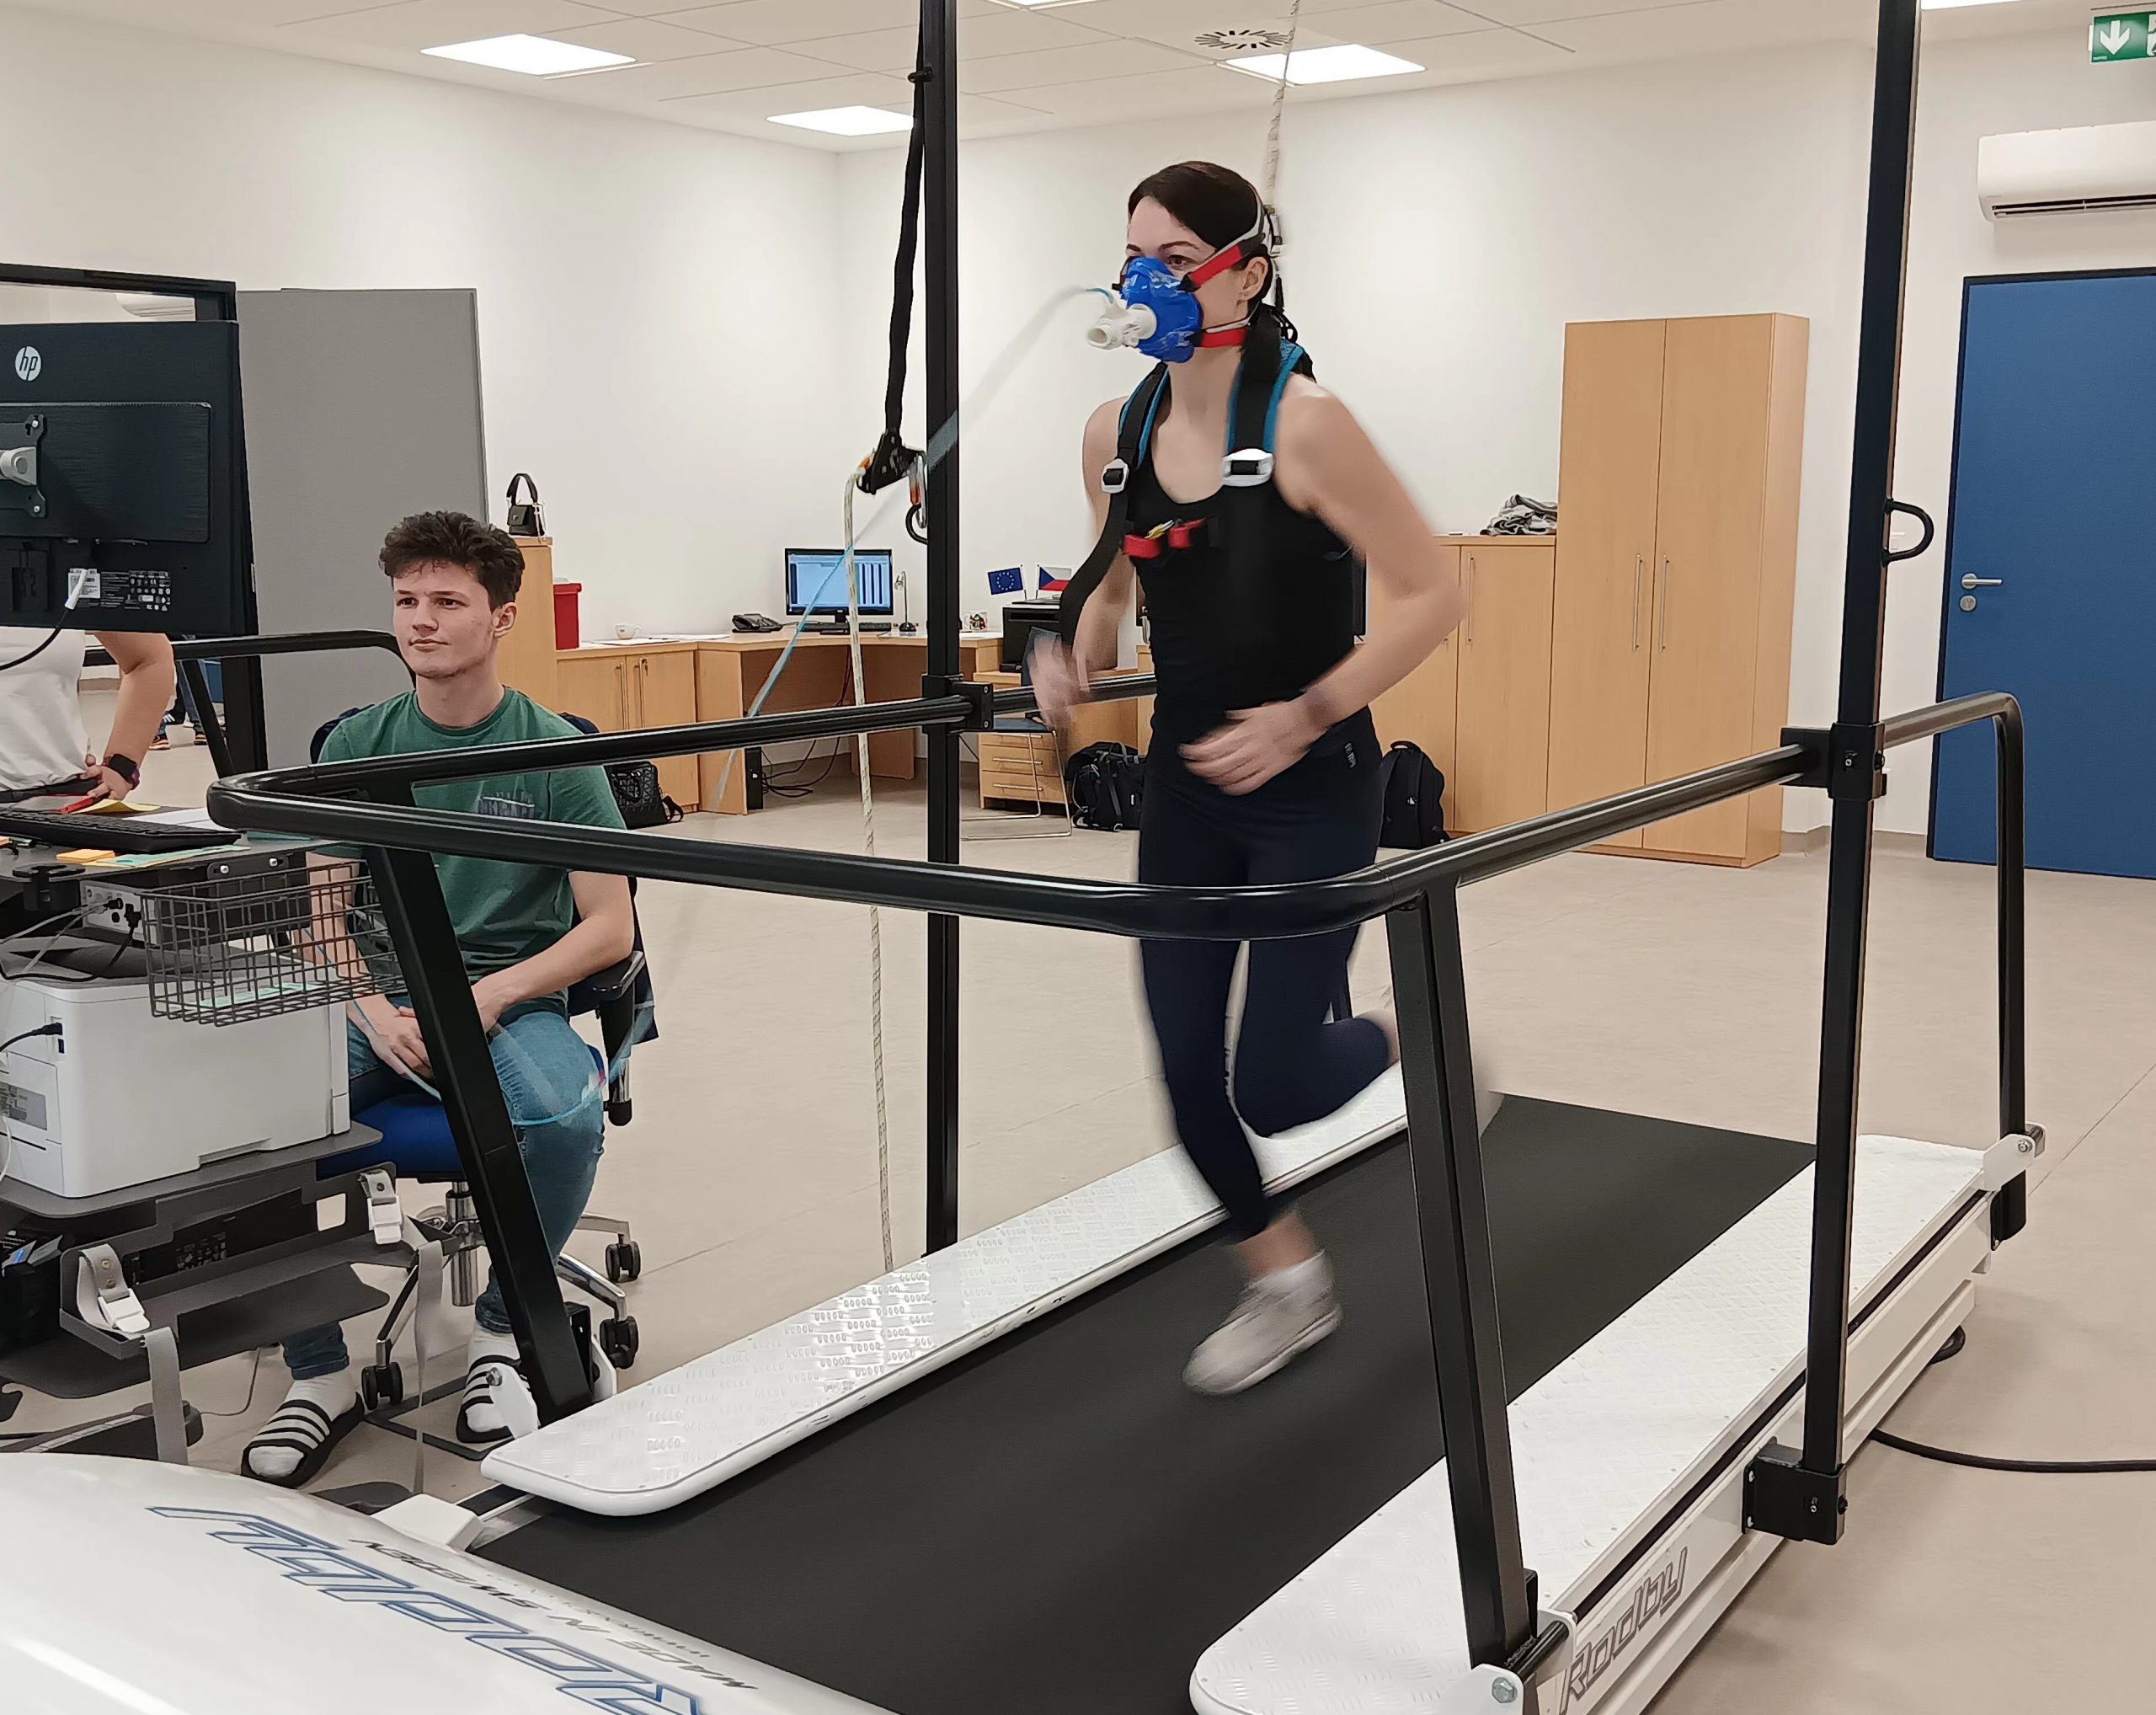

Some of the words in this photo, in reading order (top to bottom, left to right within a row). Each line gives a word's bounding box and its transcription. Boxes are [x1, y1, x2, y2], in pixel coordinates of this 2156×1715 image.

[19, 346, 39, 381] hp
[347, 1538, 553, 1611] SWEDEN
[546, 1614, 612, 1634] IN
[1559, 1546, 1688, 1715] Rodby
[606, 1638, 759, 1691] MADE
